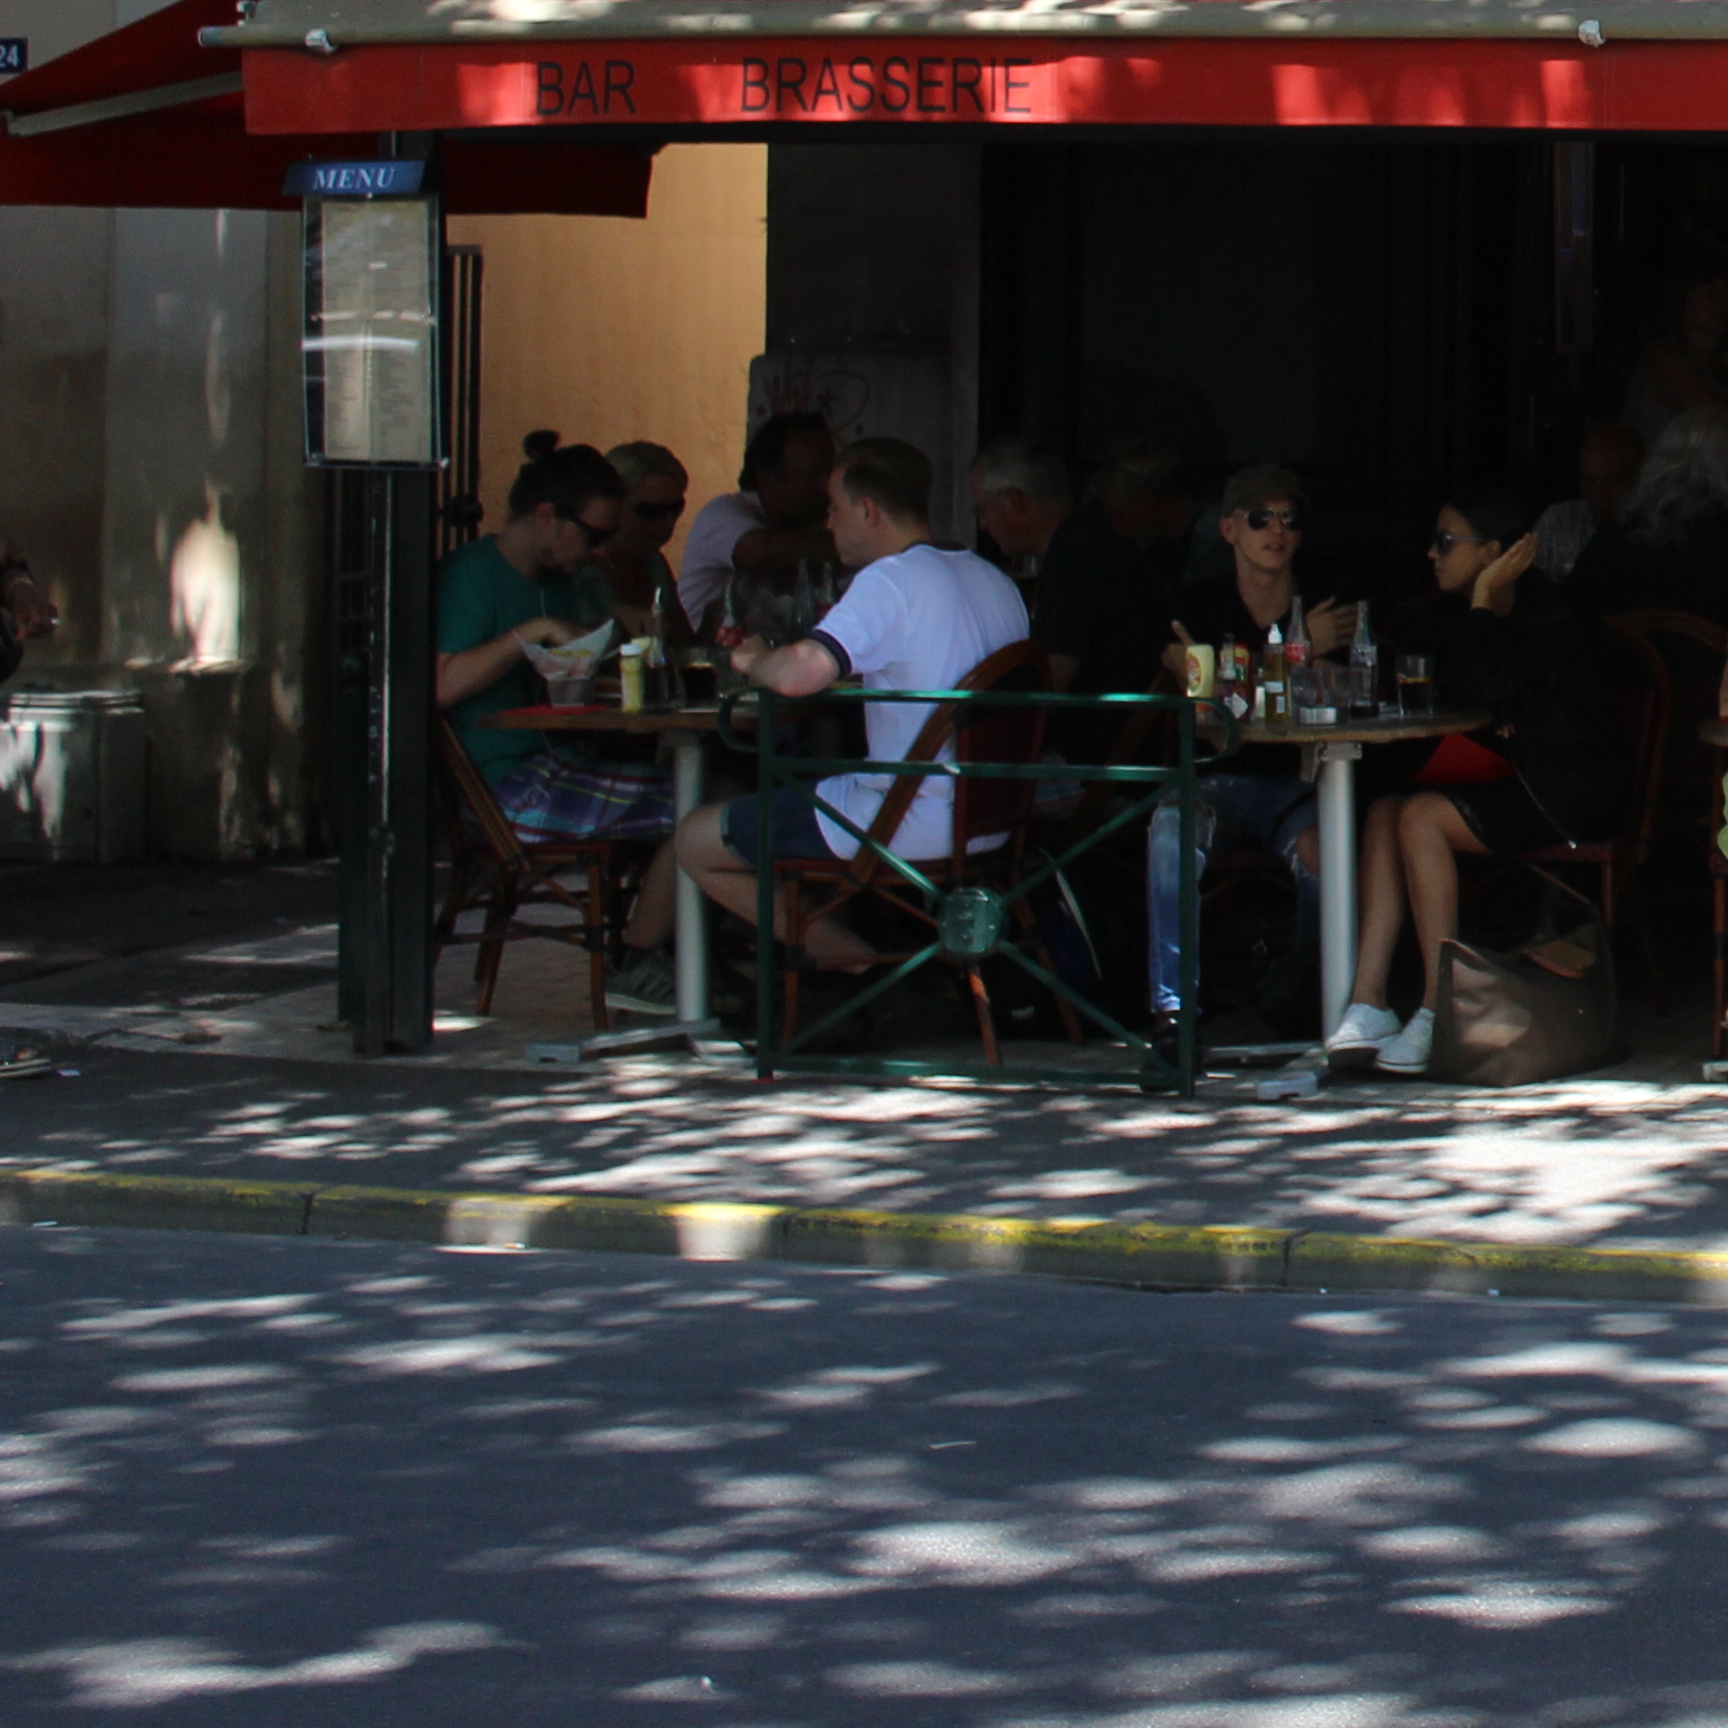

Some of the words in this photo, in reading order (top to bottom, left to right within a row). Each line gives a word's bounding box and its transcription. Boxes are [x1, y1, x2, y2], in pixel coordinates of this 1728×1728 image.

[536, 60, 637, 116] BAR
[741, 56, 1032, 113] BRASSERIE
[313, 167, 395, 190] MENU
